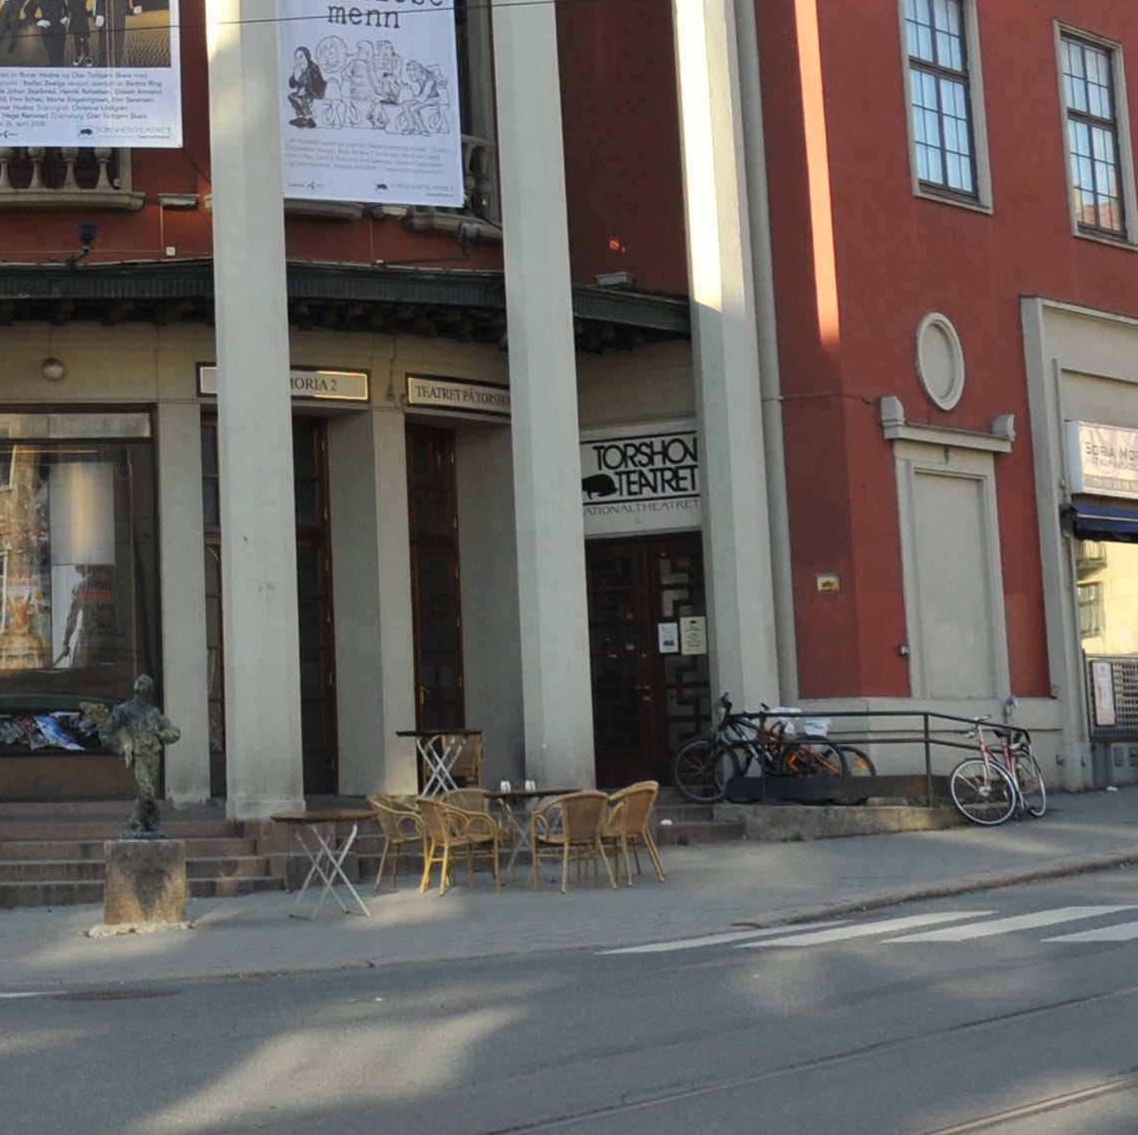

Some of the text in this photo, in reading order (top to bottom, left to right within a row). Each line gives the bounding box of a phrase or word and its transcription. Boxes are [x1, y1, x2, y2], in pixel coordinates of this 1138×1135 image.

[327, 4, 401, 29] menn
[330, 378, 338, 391] 2
[415, 384, 511, 407] TEATRET PÅ TORSHO
[613, 464, 699, 497] TEATRET
[584, 499, 700, 516] ATIONALTHEATRET
